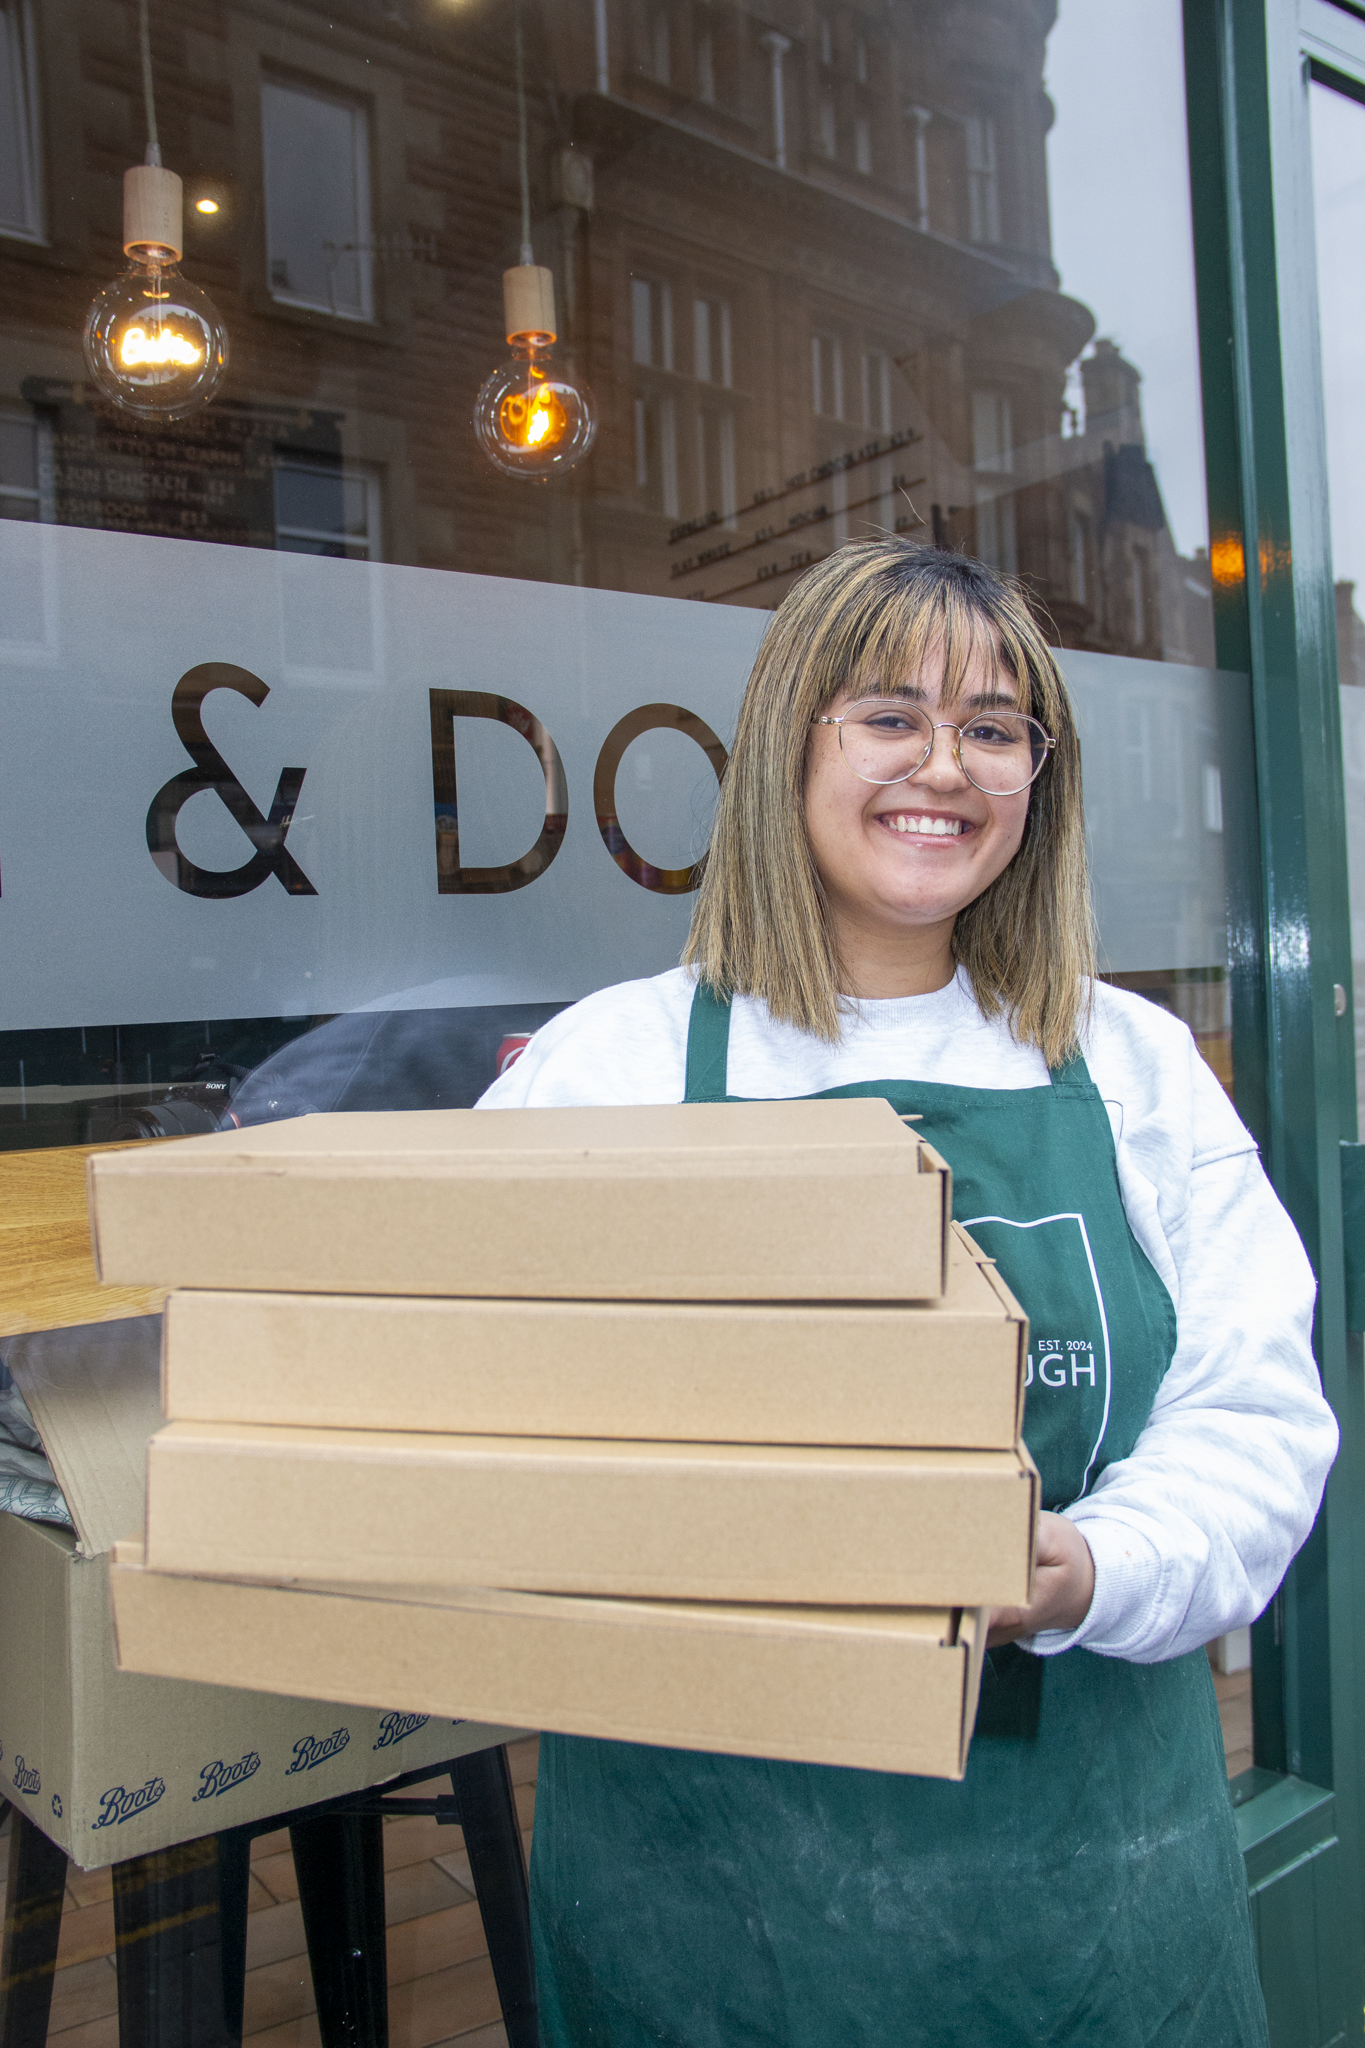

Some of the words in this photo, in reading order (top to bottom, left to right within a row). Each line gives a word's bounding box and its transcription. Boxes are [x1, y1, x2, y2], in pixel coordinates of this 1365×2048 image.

[105, 467, 188, 490] CHICKEN
[145, 661, 319, 899] &
[205, 1082, 227, 1090] SONY
[1038, 1340, 1063, 1351] EST.
[1066, 1340, 1093, 1351] 2024
[285, 1727, 350, 1775] Boots
[13, 1755, 41, 1795] Boots
[193, 1751, 261, 1802] Boots
[92, 1777, 166, 1829] Boots
